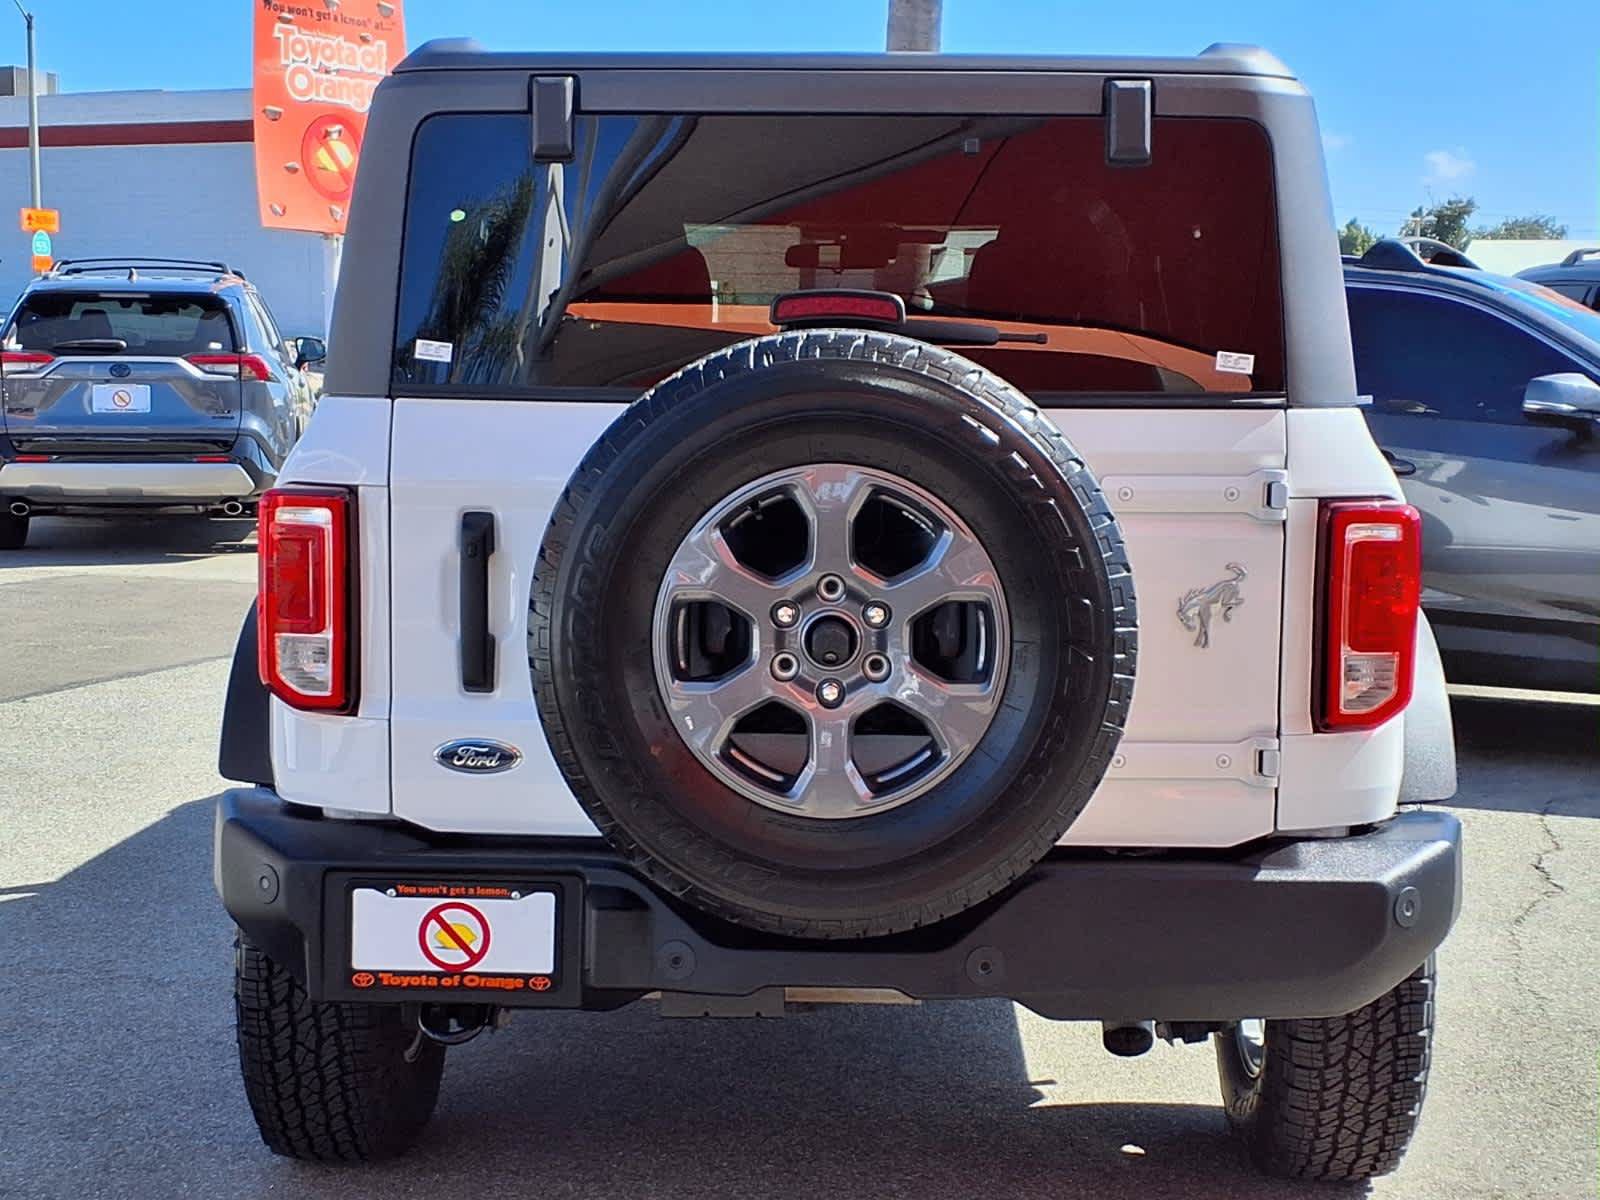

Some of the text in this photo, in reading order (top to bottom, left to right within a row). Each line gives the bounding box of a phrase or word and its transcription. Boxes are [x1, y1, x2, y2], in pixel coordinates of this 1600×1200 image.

[316, 11, 331, 22] get
[272, 23, 387, 76] Toyota of
[285, 63, 378, 113] Orang
[453, 746, 501, 767] Ford
[396, 884, 417, 894] You
[418, 885, 448, 895] won't
[449, 886, 466, 897] get
[467, 887, 476, 896] a
[378, 972, 525, 990] Toyota of Orange
